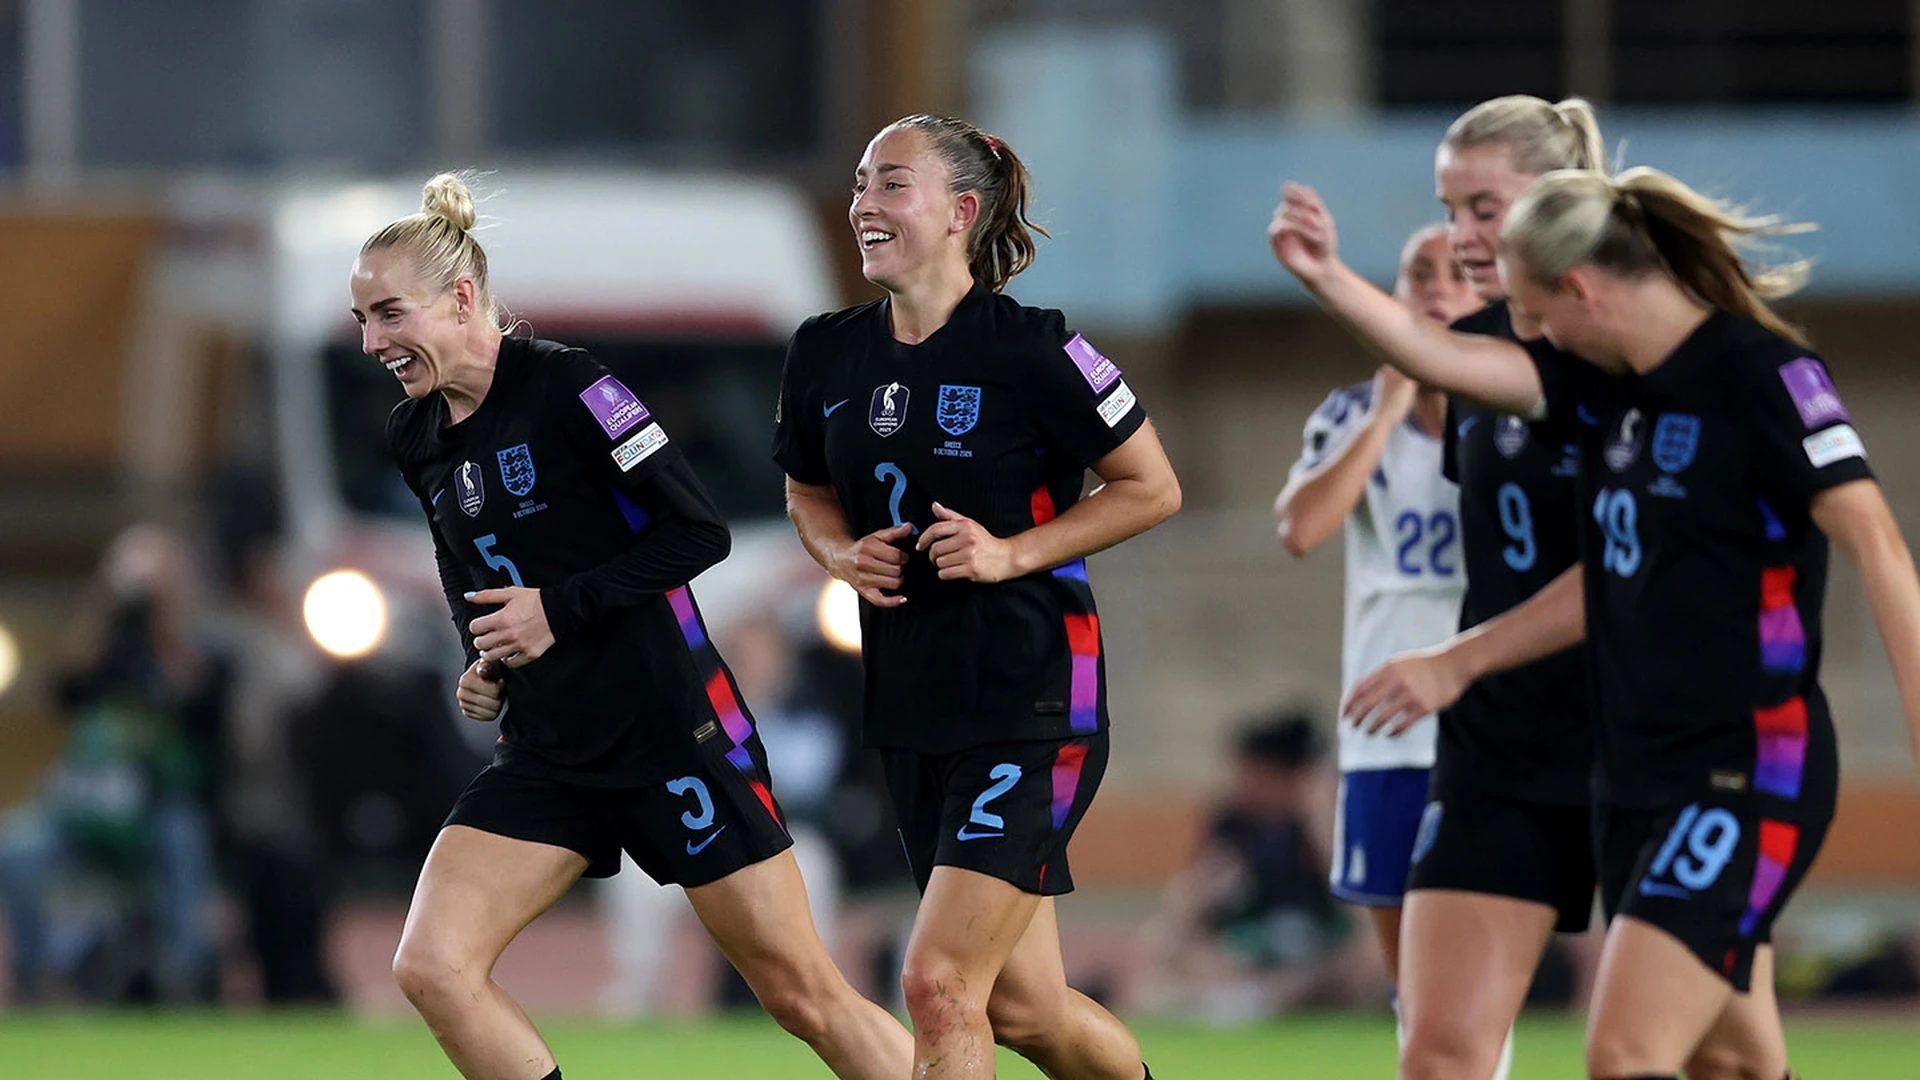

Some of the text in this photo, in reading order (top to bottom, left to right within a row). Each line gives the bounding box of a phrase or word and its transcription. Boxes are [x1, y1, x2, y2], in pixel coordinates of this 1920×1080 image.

[473, 533, 525, 587] 5
[1396, 511, 1455, 577] 22
[1498, 482, 1537, 572] 9
[1593, 487, 1641, 577] 19
[969, 763, 1022, 829] 2
[1650, 802, 1740, 889] 19
